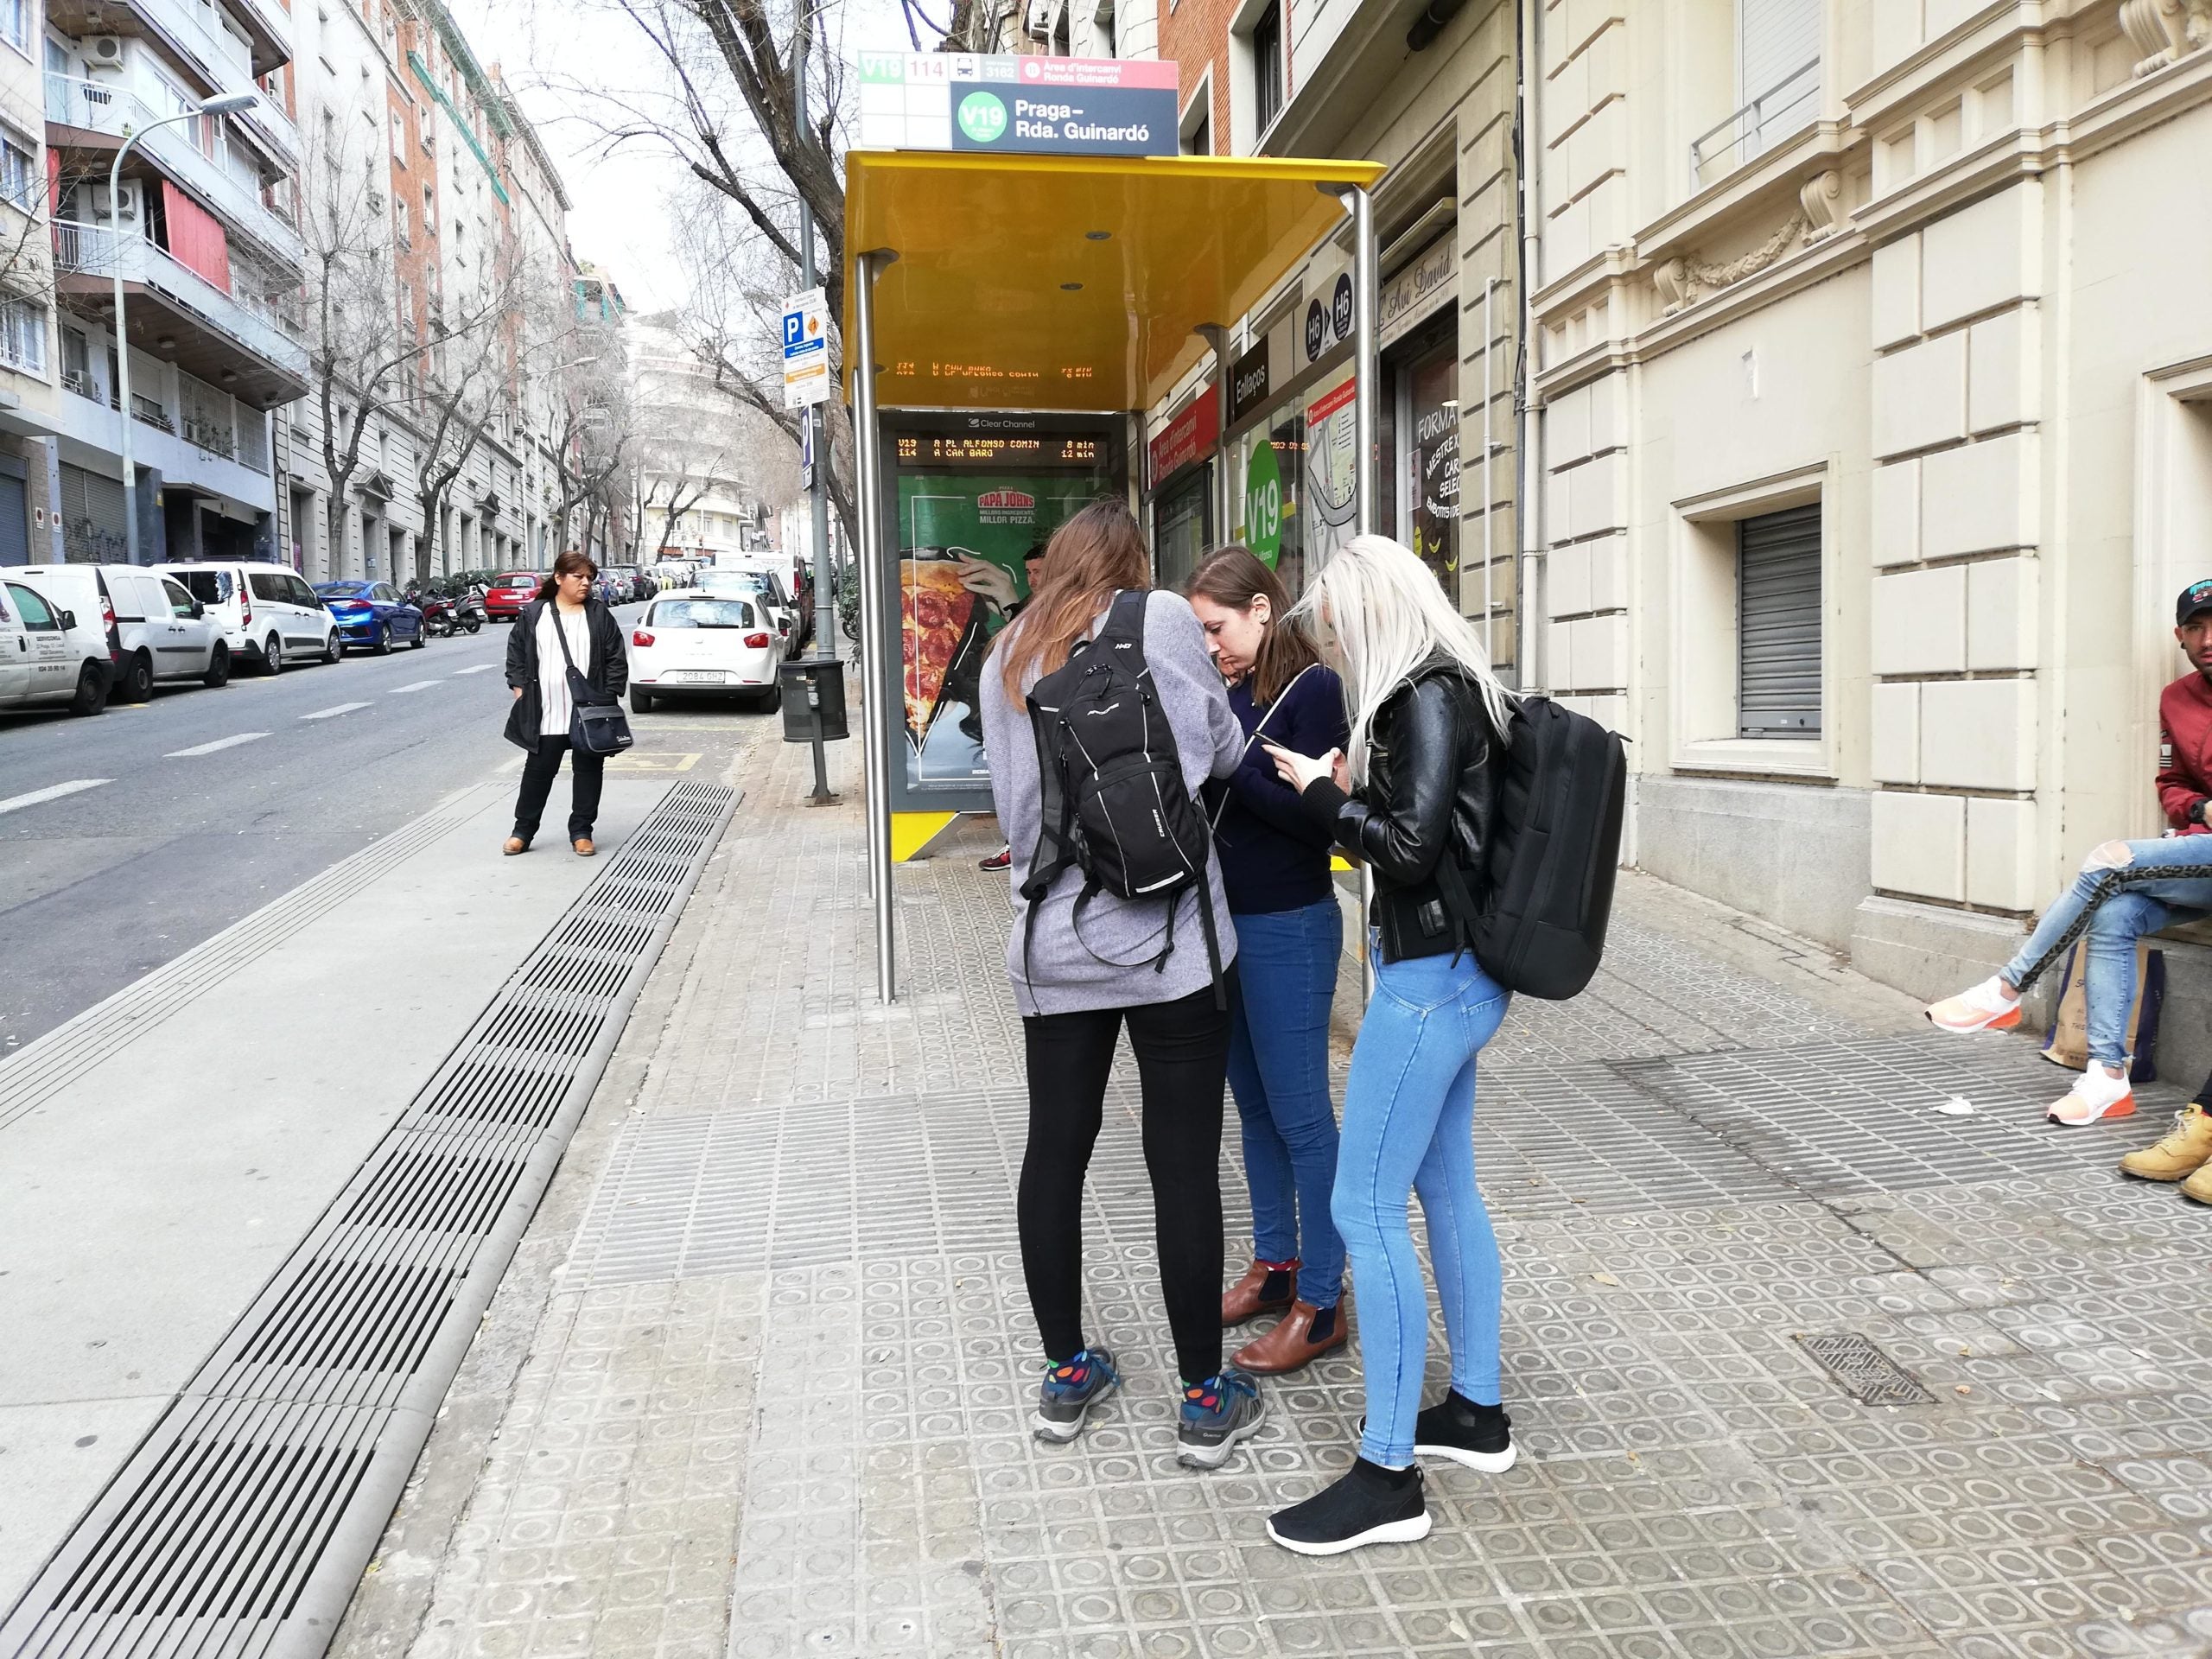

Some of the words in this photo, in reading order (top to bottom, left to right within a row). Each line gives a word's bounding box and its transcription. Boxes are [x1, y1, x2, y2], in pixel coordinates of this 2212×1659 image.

[863, 58, 902, 78] V19
[911, 60, 944, 77] 114
[986, 67, 1014, 79] 3162
[1044, 73, 1074, 83] Ronda
[1077, 73, 1119, 85] Guinardó
[962, 104, 1003, 127] V19
[1016, 121, 1059, 139] Rda.
[1065, 122, 1150, 142] Guinardó
[1336, 289, 1350, 322] H6
[786, 316, 799, 343] P
[1308, 314, 1320, 346] H6
[1236, 363, 1267, 405] Enllaços
[981, 418, 1001, 428] Clear
[1003, 420, 1035, 429] Channel
[899, 439, 917, 448] V19
[934, 439, 940, 448] A
[963, 439, 1005, 448] ALFONSO
[1009, 440, 1039, 448] COMIN
[1077, 440, 1095, 449] min
[934, 448, 940, 457] A
[945, 448, 964, 457] CAN
[1077, 449, 1095, 458] min
[1445, 457, 1459, 479] CAR
[1440, 476, 1459, 499] SELEC
[979, 493, 1002, 507] PAPA
[1004, 492, 1033, 507] JOHNS
[980, 516, 1007, 524] MILLOR
[1010, 516, 1035, 524] PIZZA.
[1247, 479, 1279, 544] V19
[683, 672, 704, 681] 2084
[1152, 809, 1166, 837] CRUISER
